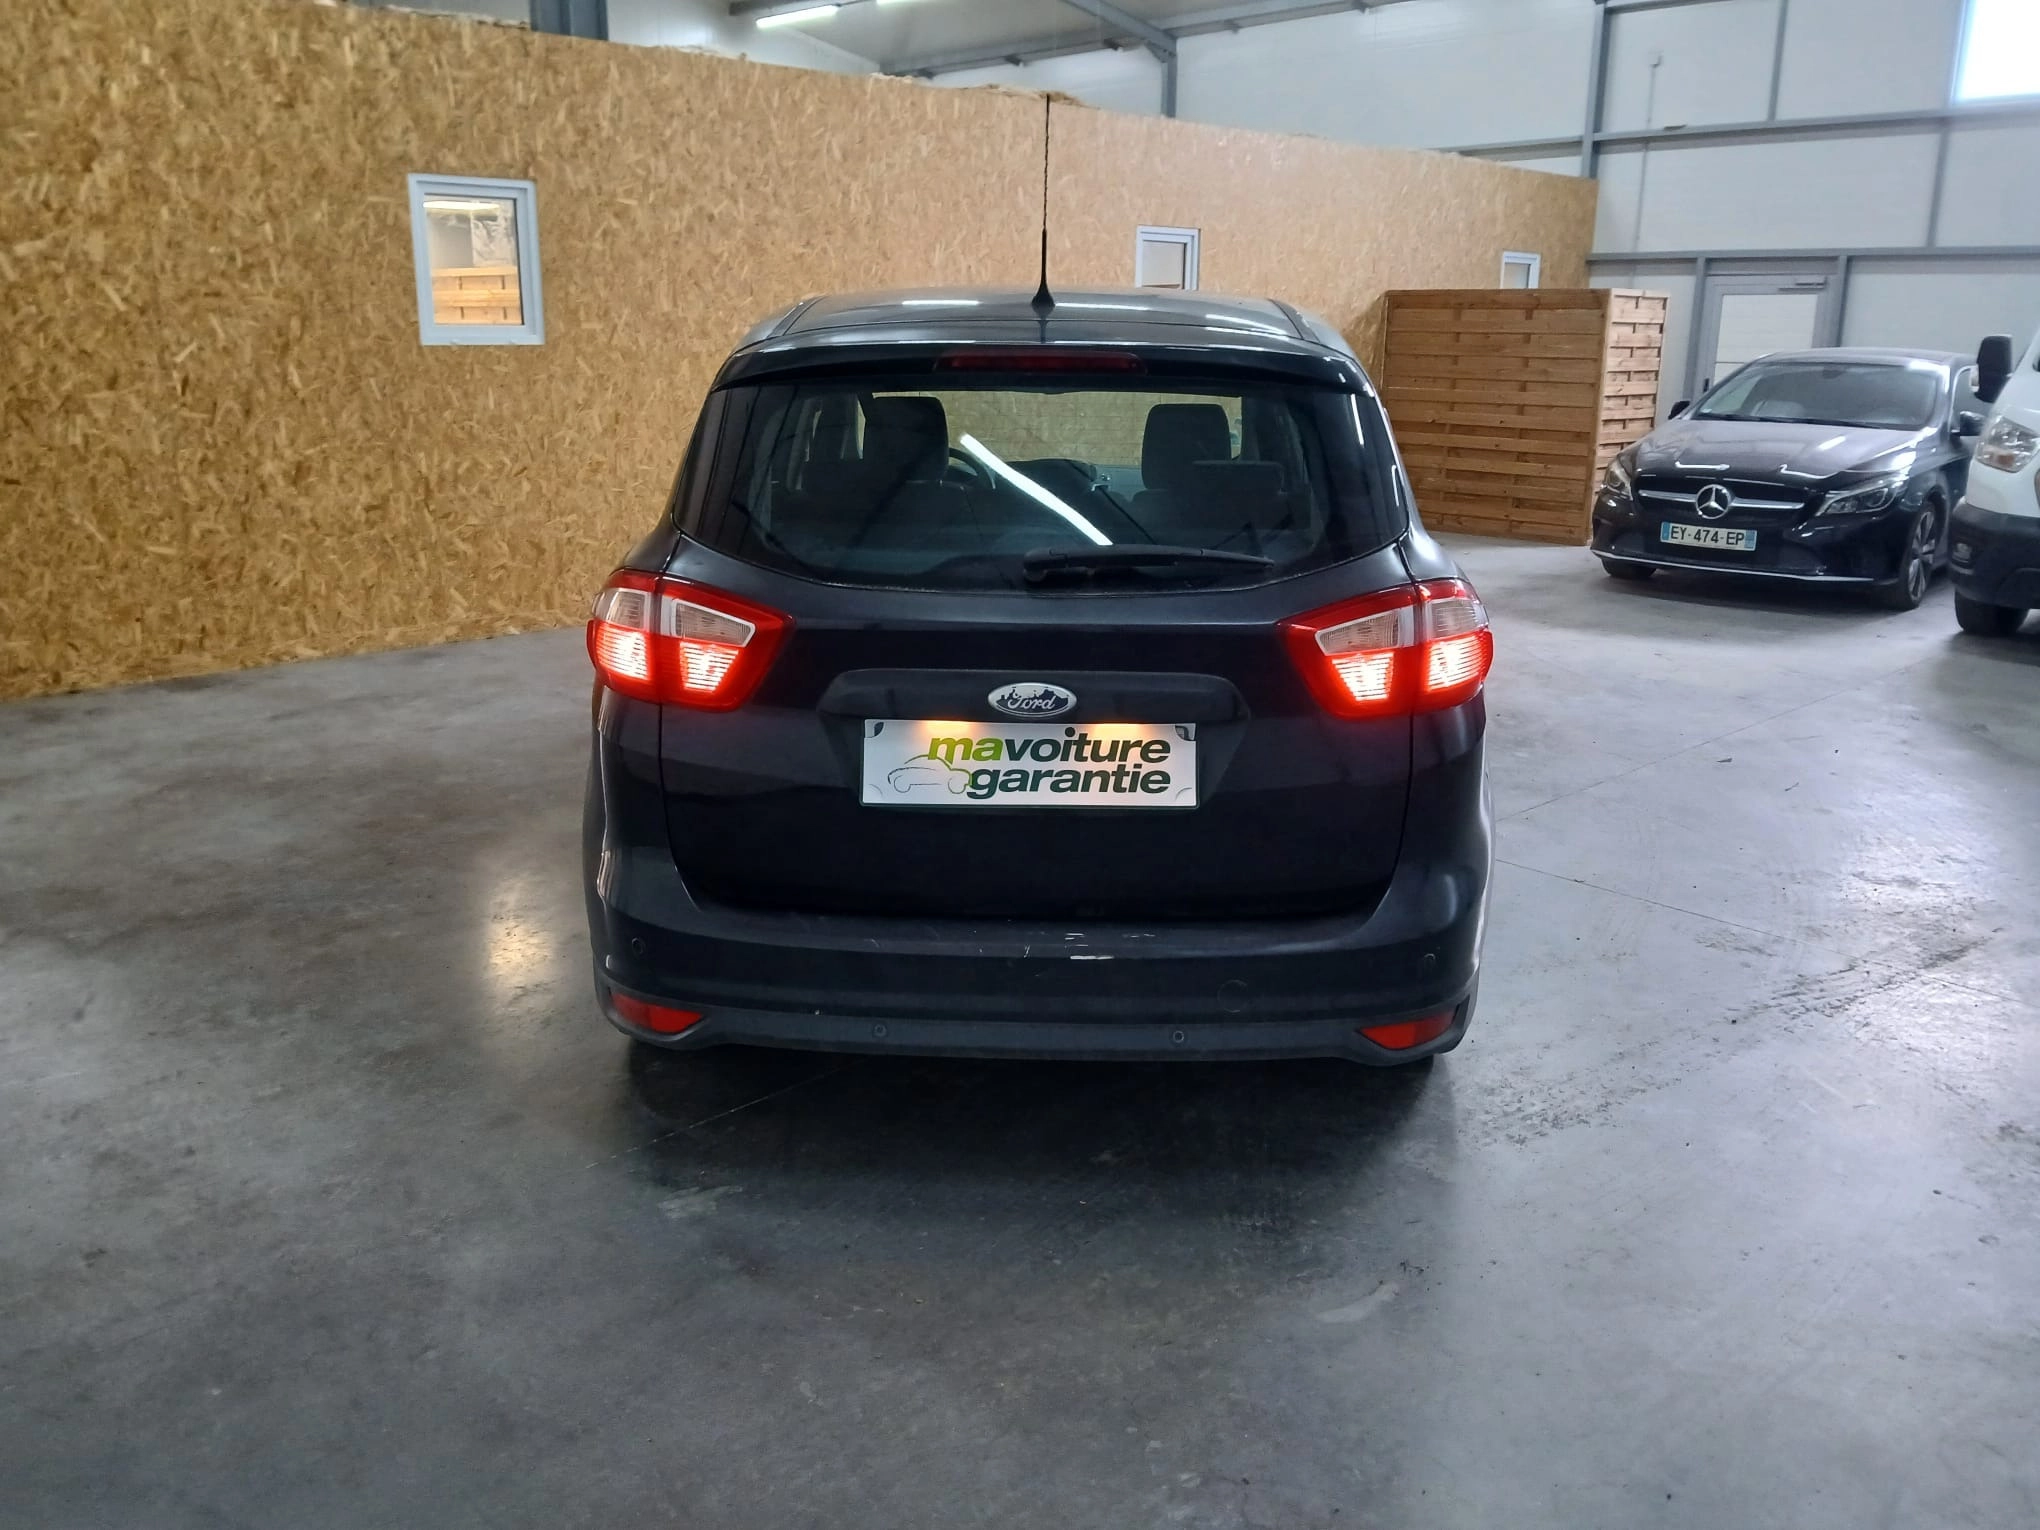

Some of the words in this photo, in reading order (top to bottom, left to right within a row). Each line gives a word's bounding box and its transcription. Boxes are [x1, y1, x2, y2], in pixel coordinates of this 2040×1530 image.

[1670, 526, 1745, 545] EY-474-EP
[1007, 690, 1057, 710] Ford
[927, 727, 1171, 763] mavoiture
[967, 764, 1171, 799] garantie
